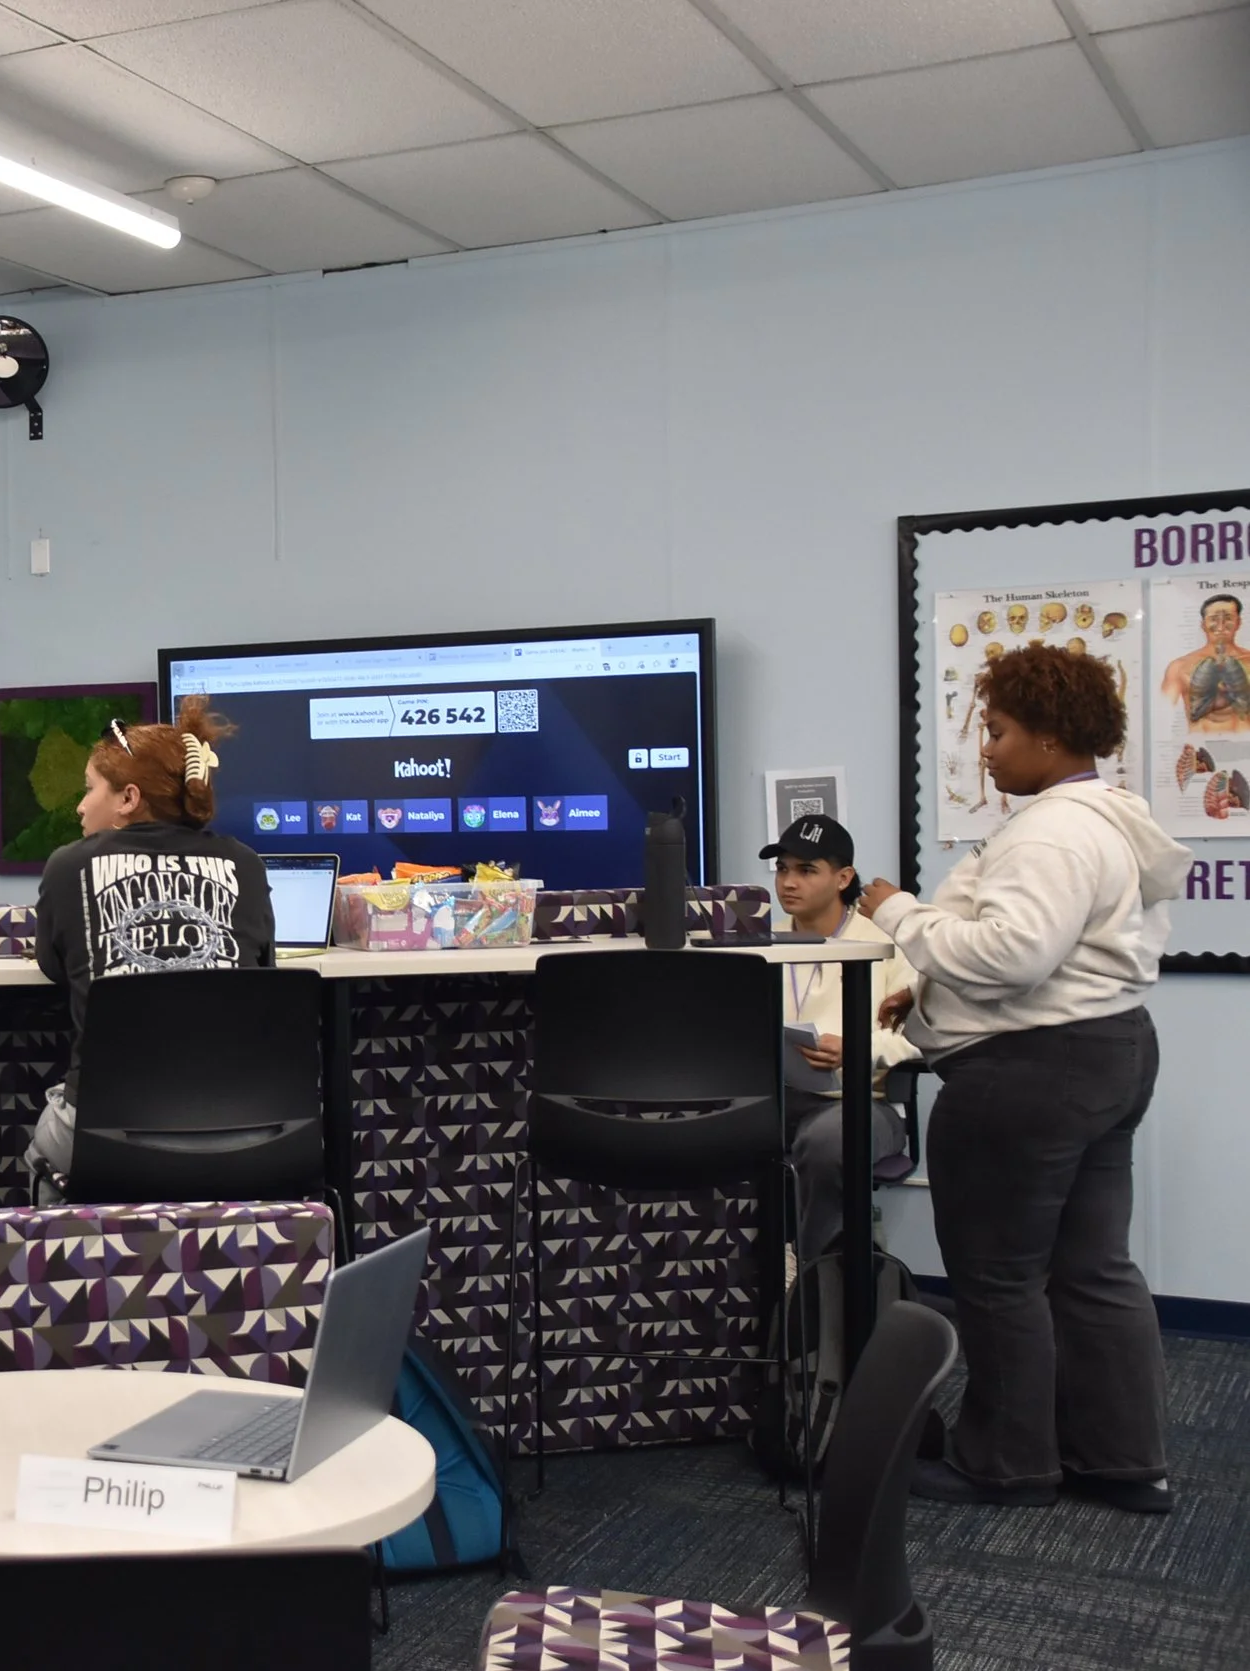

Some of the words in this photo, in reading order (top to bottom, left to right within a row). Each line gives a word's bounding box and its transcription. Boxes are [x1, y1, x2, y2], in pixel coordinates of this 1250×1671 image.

[1134, 521, 1250, 568] BORR
[1197, 581, 1219, 589] The
[982, 595, 1003, 603] The
[1005, 593, 1043, 602] Human
[1045, 589, 1089, 599] Skeleton
[400, 708, 441, 725] 426
[446, 706, 486, 724] 542
[658, 753, 681, 761] Start
[394, 758, 451, 778] Kahoot!
[285, 813, 301, 822] Lee
[346, 812, 362, 822] Kat
[407, 809, 445, 822] Nataliya
[492, 809, 519, 820] Elena
[568, 807, 600, 818] Aimee
[91, 854, 152, 897] WHO
[157, 855, 181, 872] IS
[184, 856, 239, 897] THIS
[1186, 860, 1250, 900] RET
[96, 875, 147, 933] KING
[144, 872, 174, 921] OF
[175, 872, 237, 930] GLORY
[98, 924, 159, 967] THE
[83, 1476, 165, 1516] Philip
